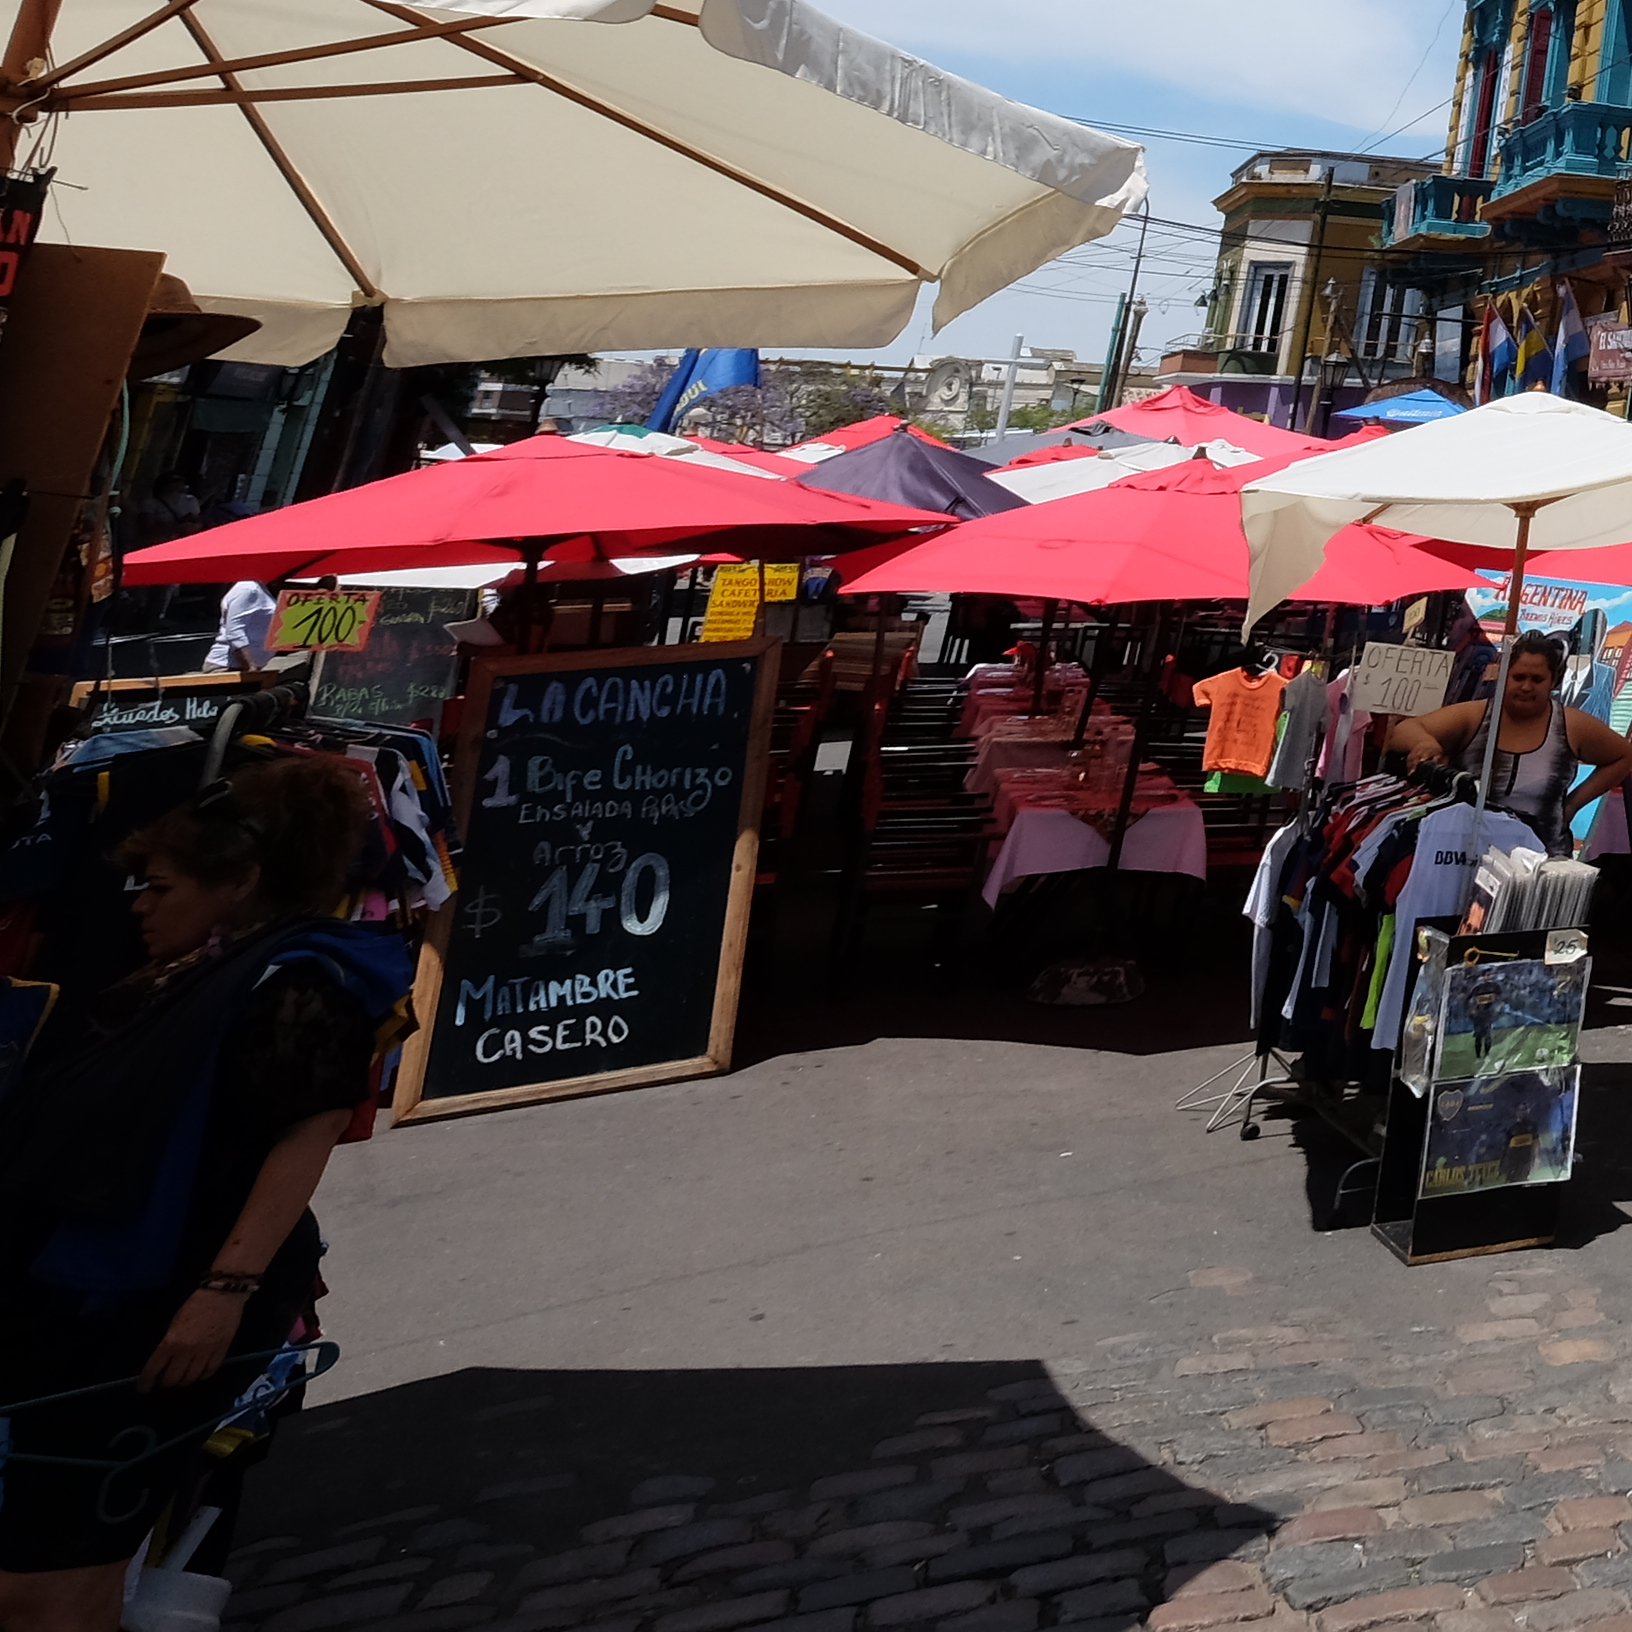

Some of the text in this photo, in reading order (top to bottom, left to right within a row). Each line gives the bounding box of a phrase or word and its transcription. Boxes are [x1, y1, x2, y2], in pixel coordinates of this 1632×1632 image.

[720, 577, 759, 587] TANGO
[1367, 643, 1450, 679] OFERTA
[497, 668, 728, 728] LA CANCHA
[481, 754, 521, 809] 1
[527, 851, 671, 945] 140
[474, 1013, 630, 1065] CASERO
